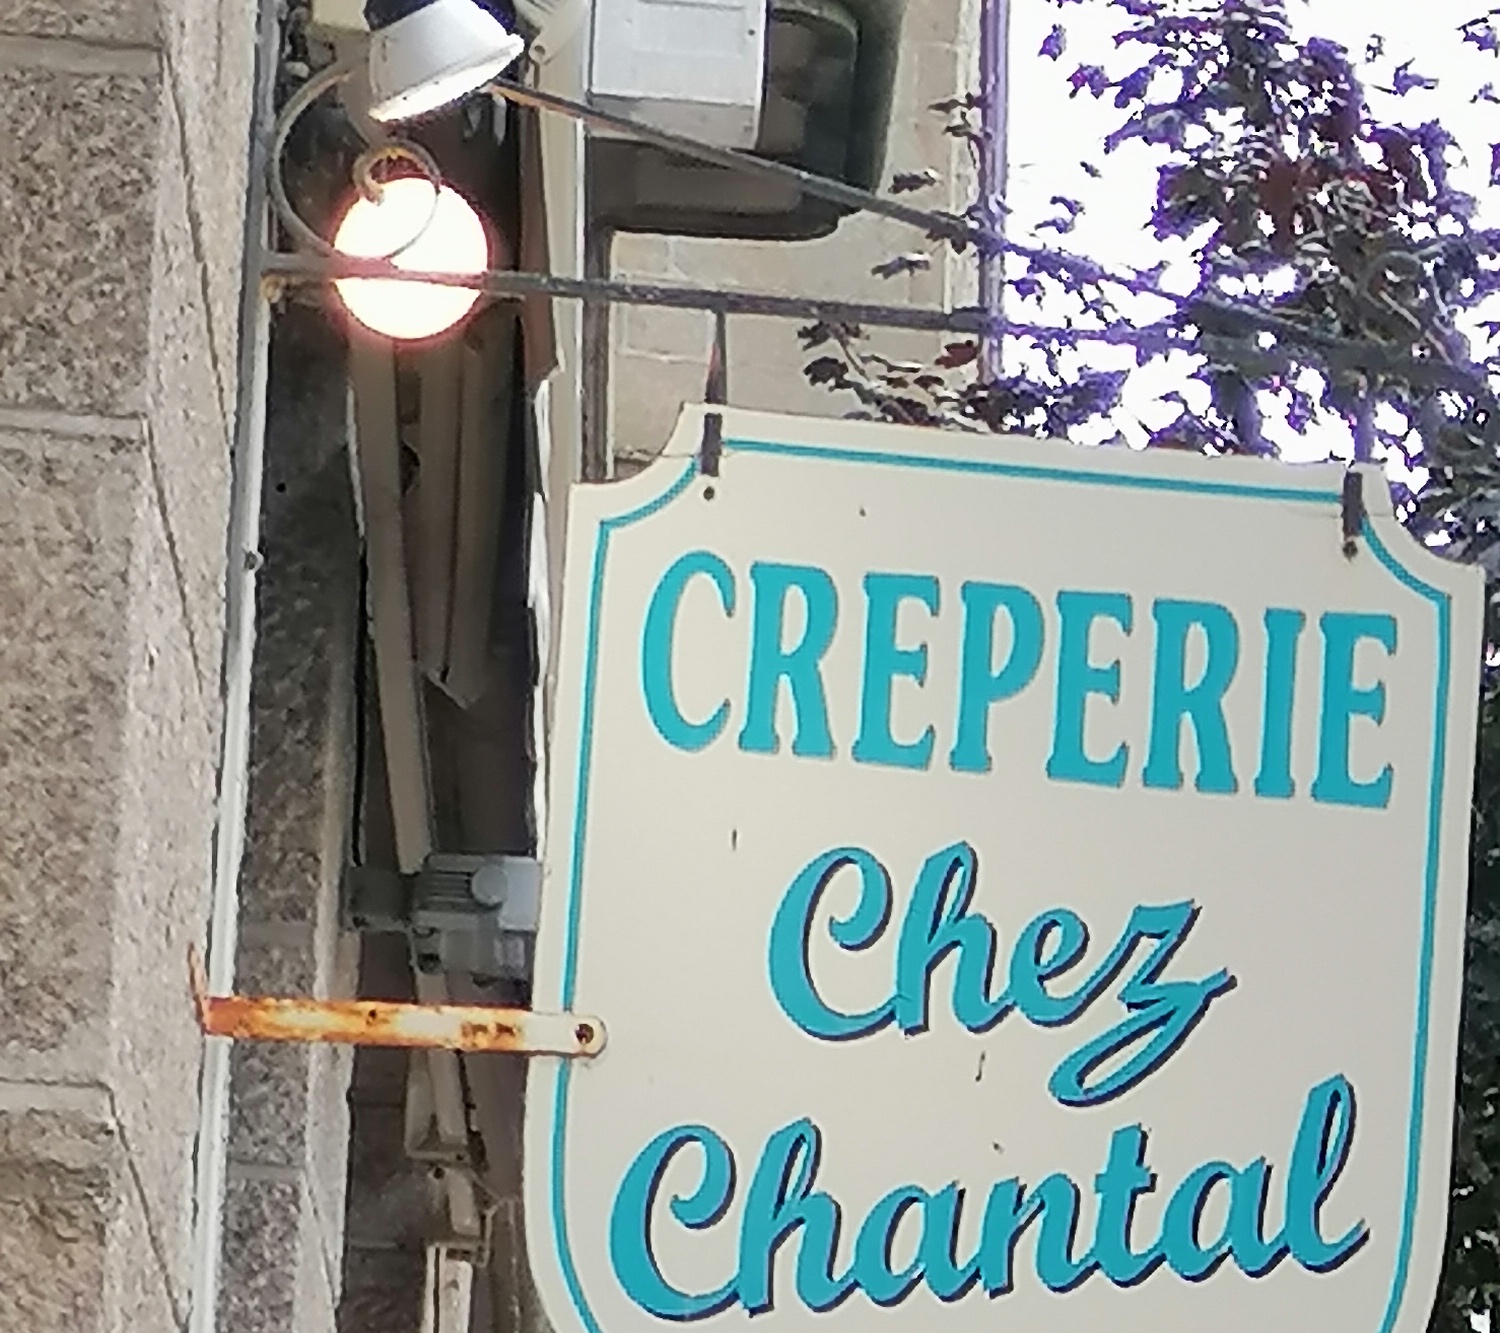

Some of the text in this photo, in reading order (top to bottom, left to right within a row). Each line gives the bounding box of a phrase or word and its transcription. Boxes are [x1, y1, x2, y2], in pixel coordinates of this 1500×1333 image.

[640, 549, 1399, 809] CREPERIE
[767, 840, 1237, 1107] Chez
[608, 1074, 1371, 1323] Chantal
